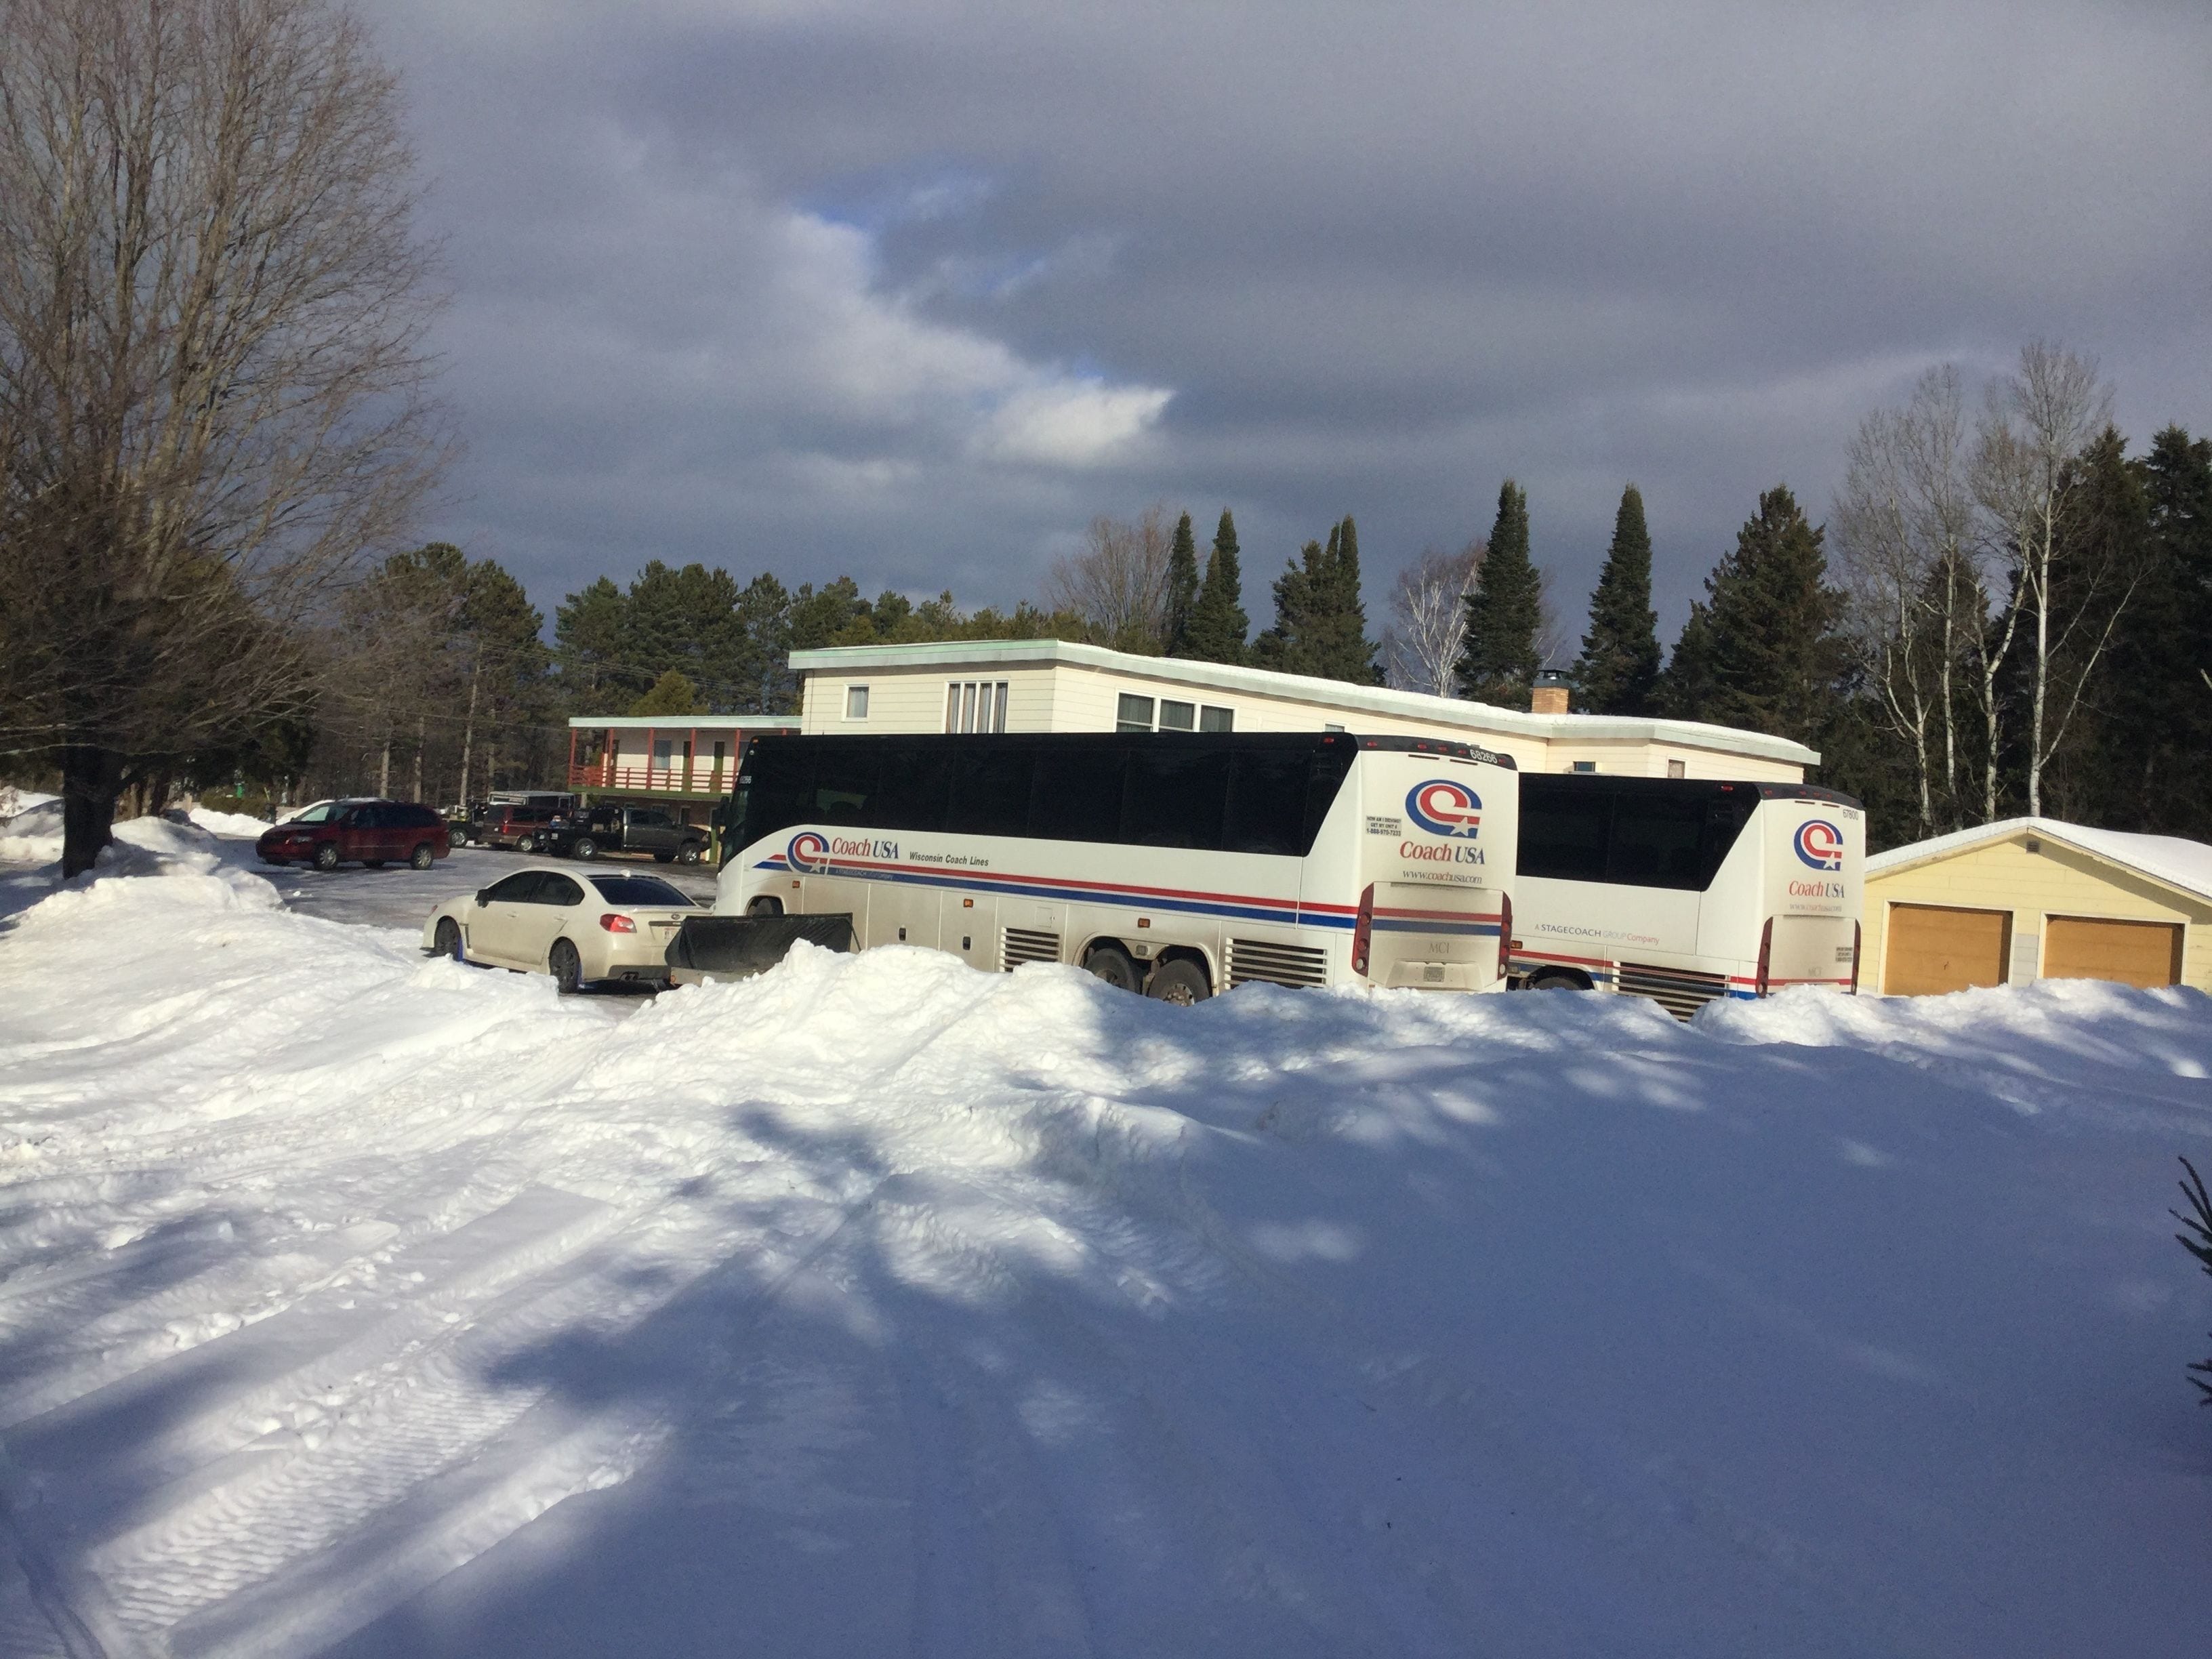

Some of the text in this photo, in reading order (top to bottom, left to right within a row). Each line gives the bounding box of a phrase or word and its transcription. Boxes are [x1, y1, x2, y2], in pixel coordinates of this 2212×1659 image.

[1470, 749, 1498, 764] 68266
[832, 837, 899, 859] Coach USA
[1399, 841, 1485, 865] Coach USA
[909, 851, 989, 867] Wisconsin Coach Lines
[1403, 870, 1483, 884] www.coachusa.com
[1788, 880, 1845, 898] Coach USA
[1541, 924, 1602, 937] STAGECOACH
[1603, 930, 1626, 940] GROUP
[1626, 933, 1660, 946] Company
